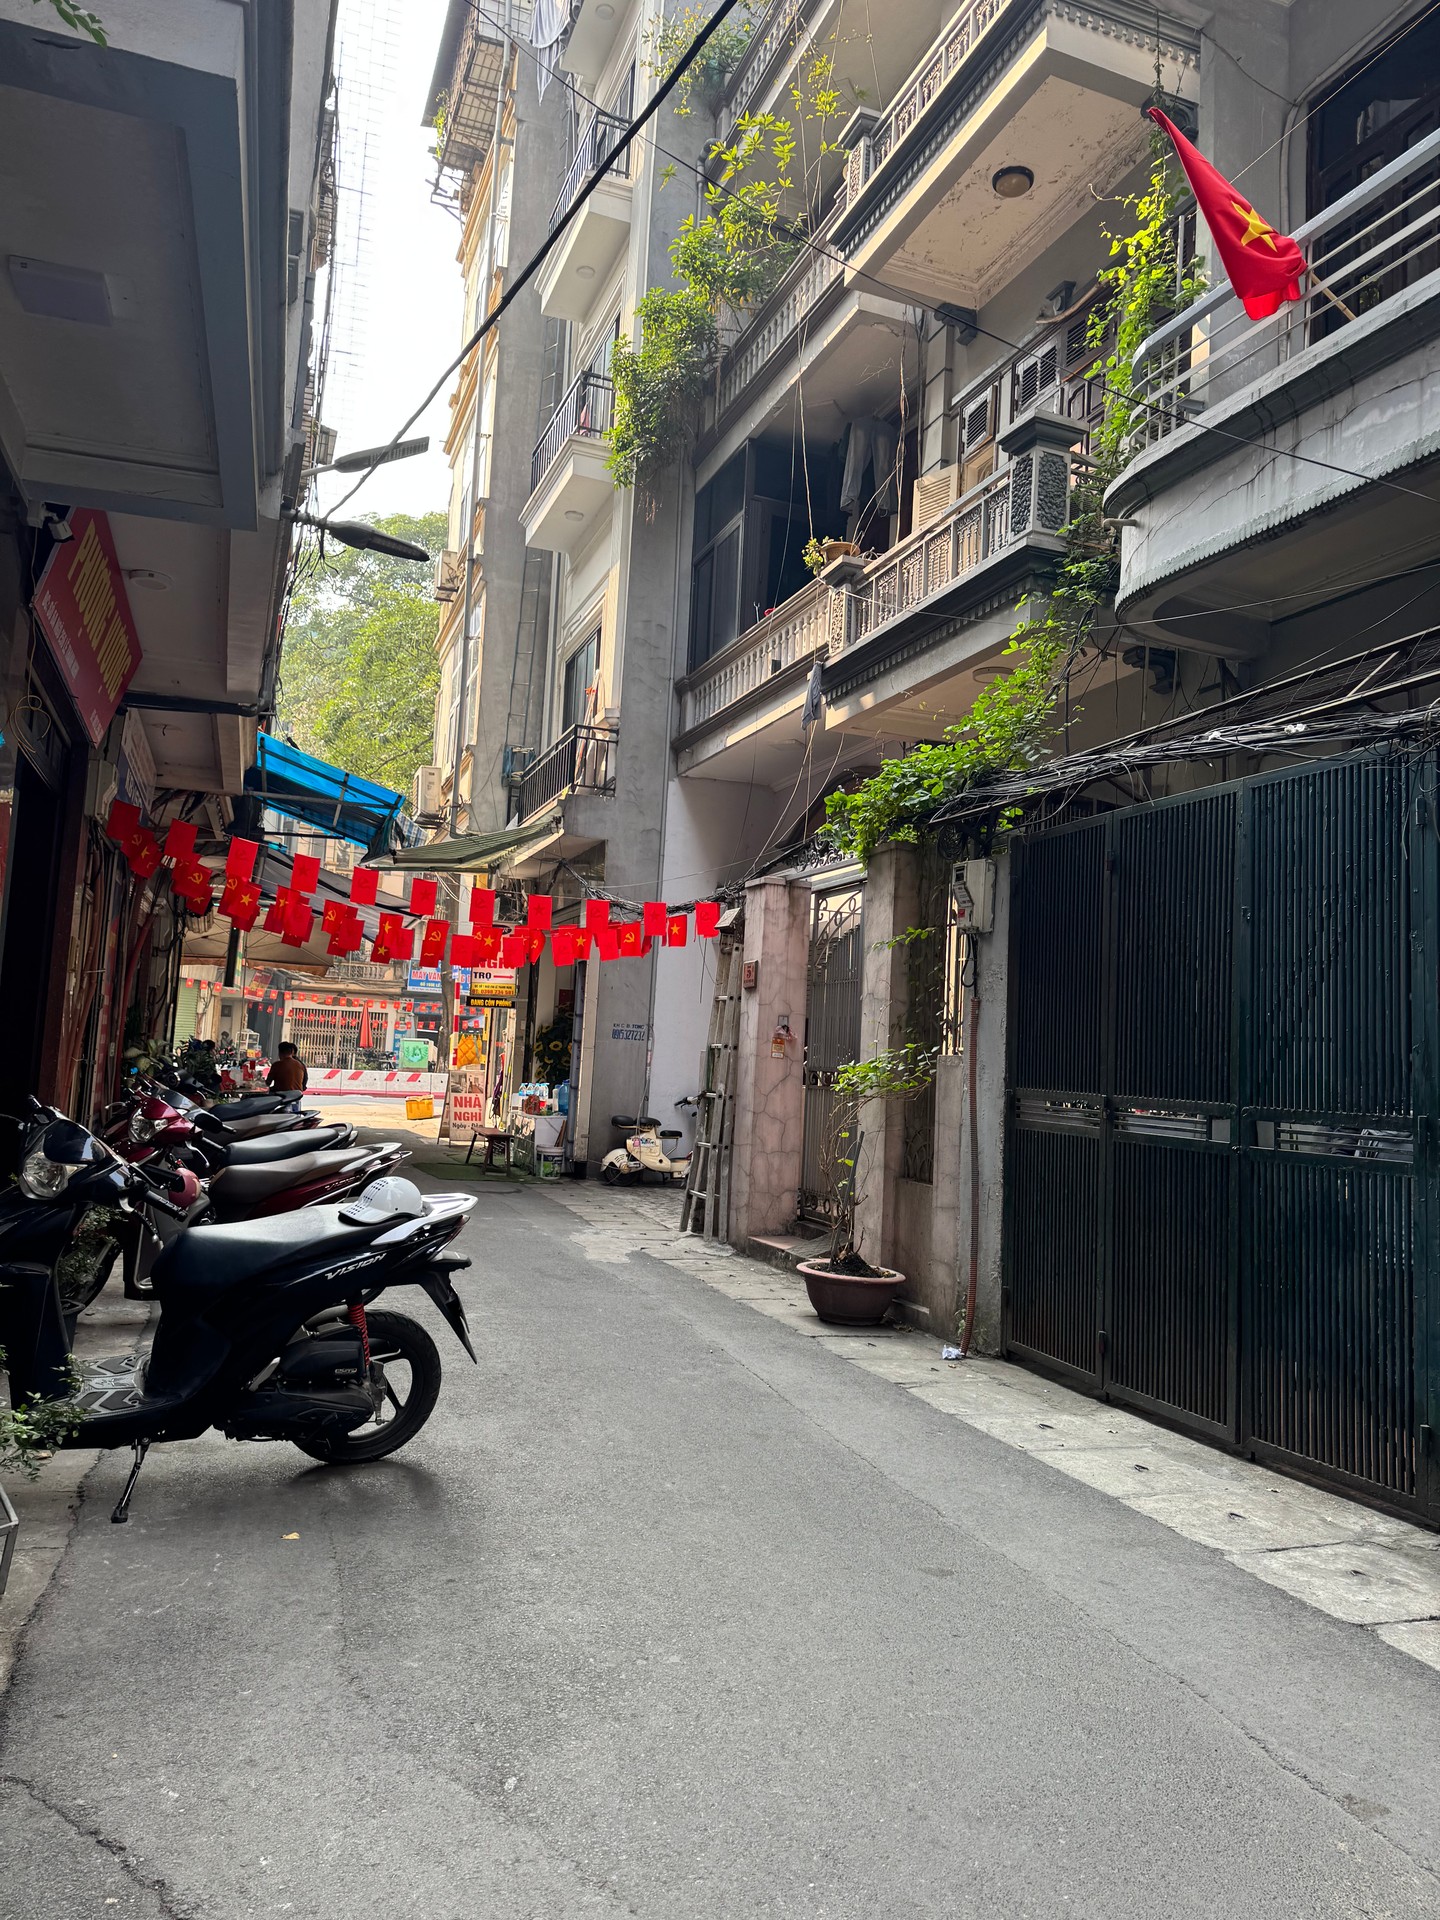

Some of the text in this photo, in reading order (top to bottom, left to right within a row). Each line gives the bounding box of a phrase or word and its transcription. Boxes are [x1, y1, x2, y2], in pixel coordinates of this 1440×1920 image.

[67, 518, 133, 703] PHƯỢNG VƯỢNG
[473, 971, 492, 981] TRỌ
[453, 1094, 482, 1108] NHÀ
[324, 1253, 387, 1281] VISION
